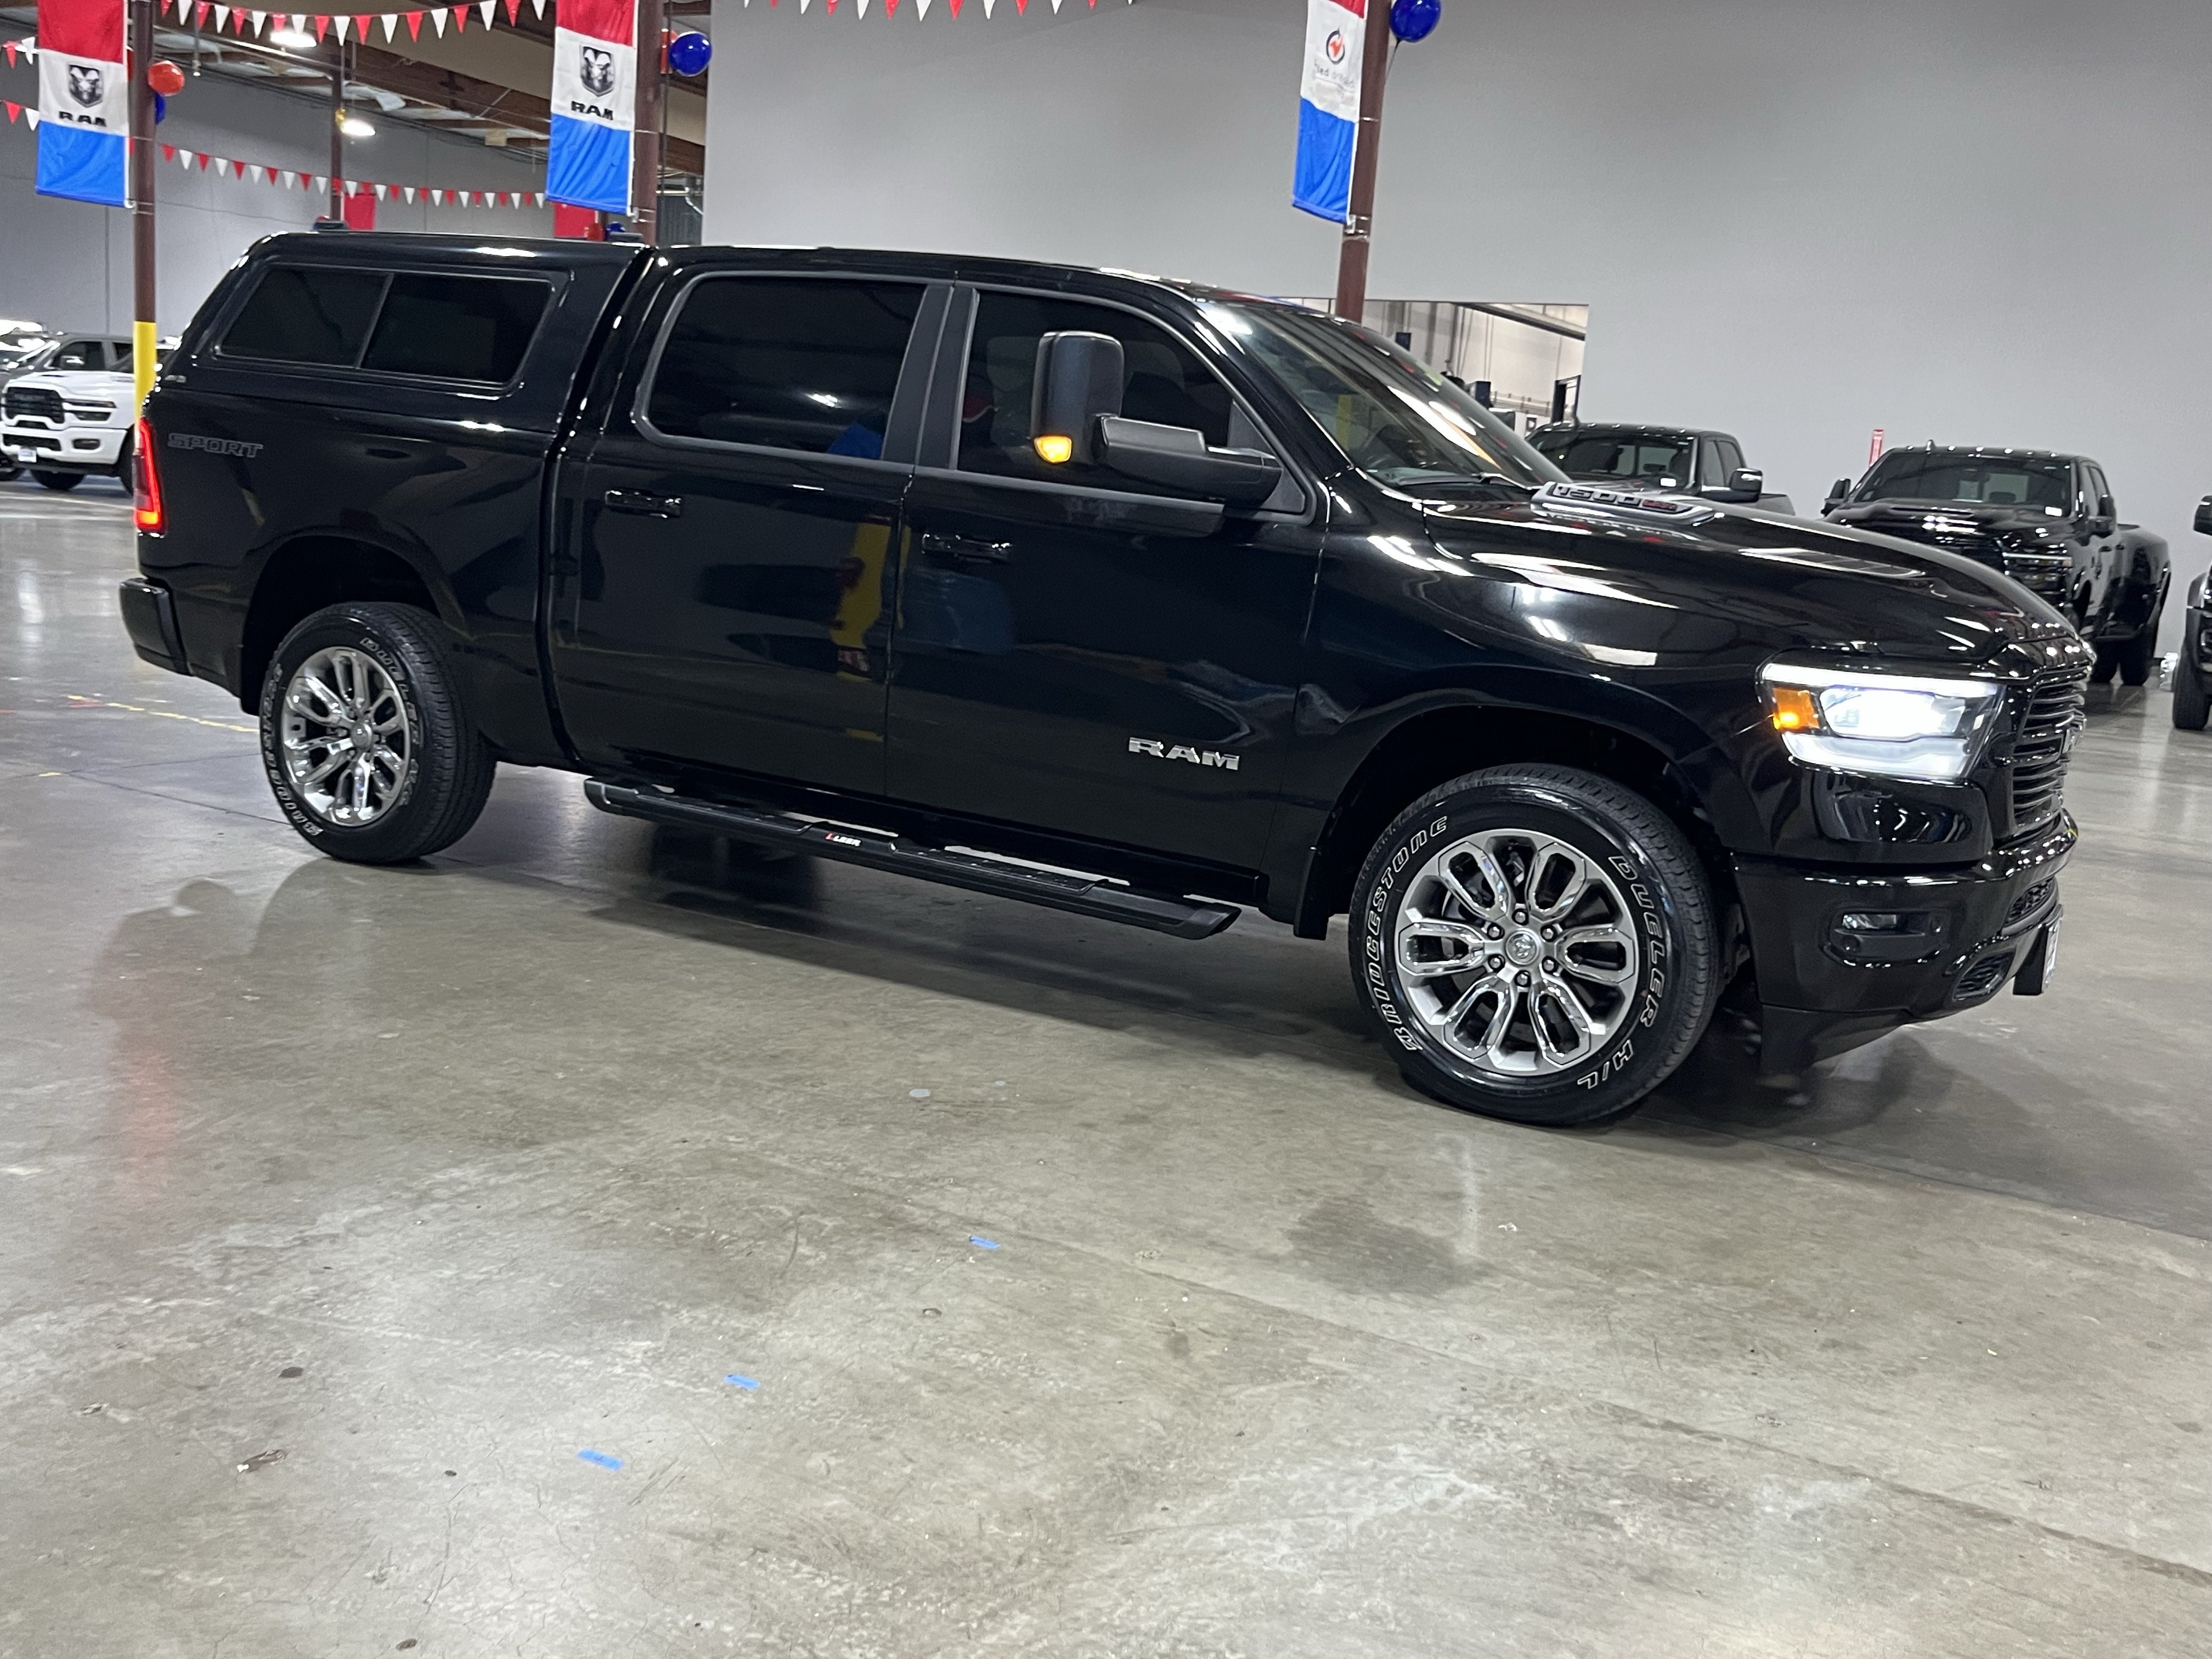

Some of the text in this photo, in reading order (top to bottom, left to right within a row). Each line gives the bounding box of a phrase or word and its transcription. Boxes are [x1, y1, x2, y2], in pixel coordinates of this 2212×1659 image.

[59, 111, 107, 127] RAM
[571, 100, 613, 121] RAM
[167, 433, 263, 458] SPORT
[1556, 484, 1640, 506] 1500
[1128, 737, 1240, 771] RAM
[1367, 815, 1448, 1051] BRIDGESTONE
[1608, 856, 1665, 1027] DUELER
